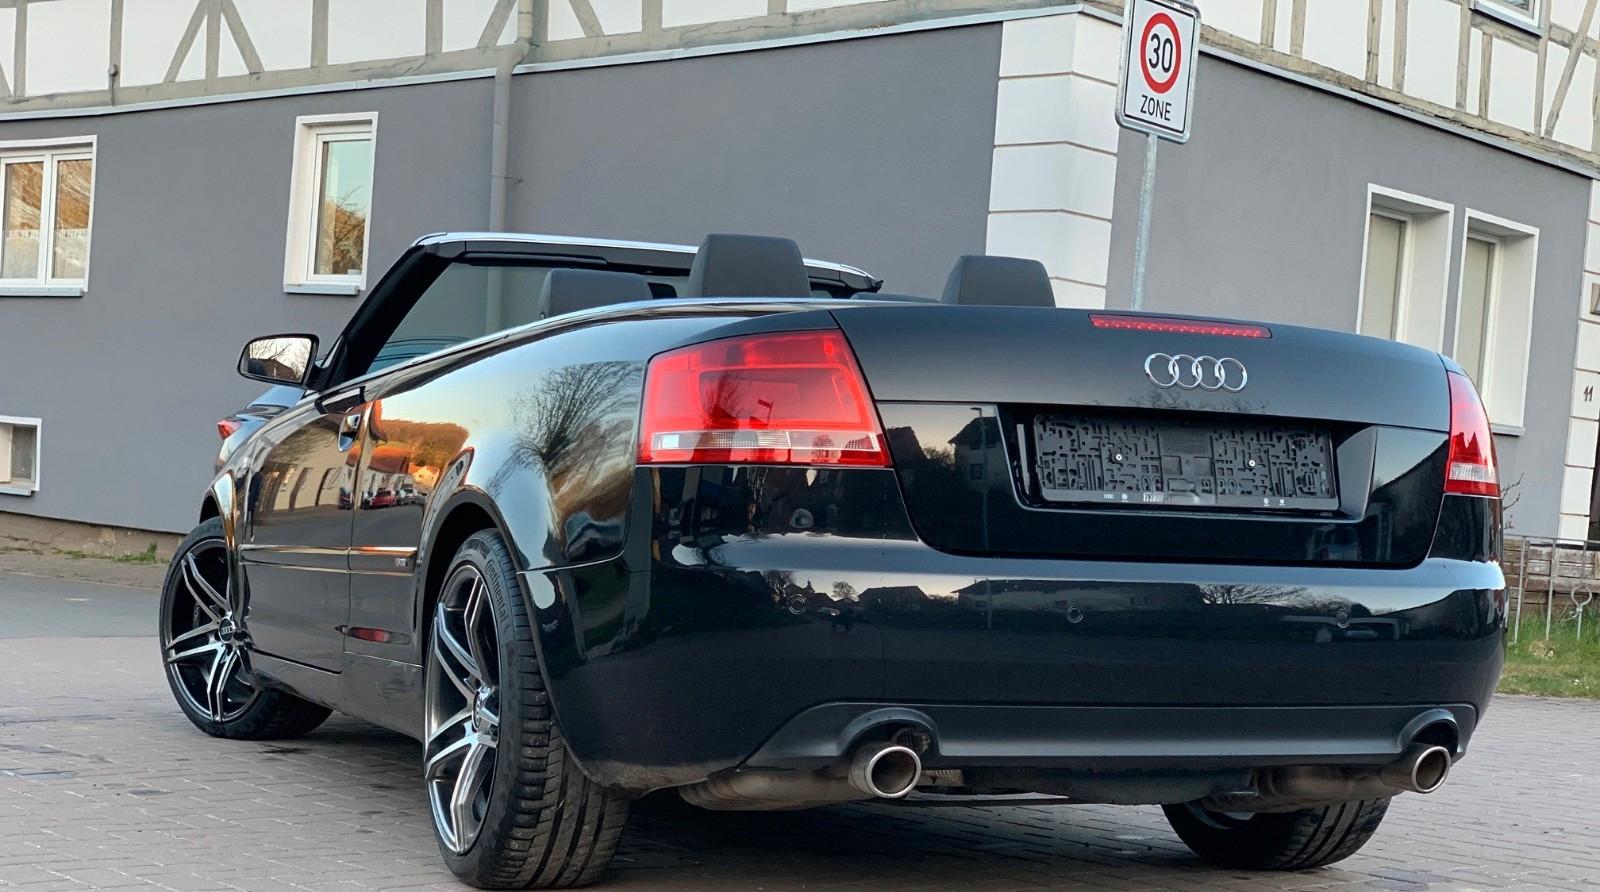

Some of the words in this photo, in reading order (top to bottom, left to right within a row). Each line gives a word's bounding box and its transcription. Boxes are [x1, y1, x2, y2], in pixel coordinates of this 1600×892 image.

[1149, 33, 1173, 73] 30
[1140, 94, 1172, 121] ZONE
[1584, 385, 1594, 402] 11
[485, 558, 508, 623] Continental
